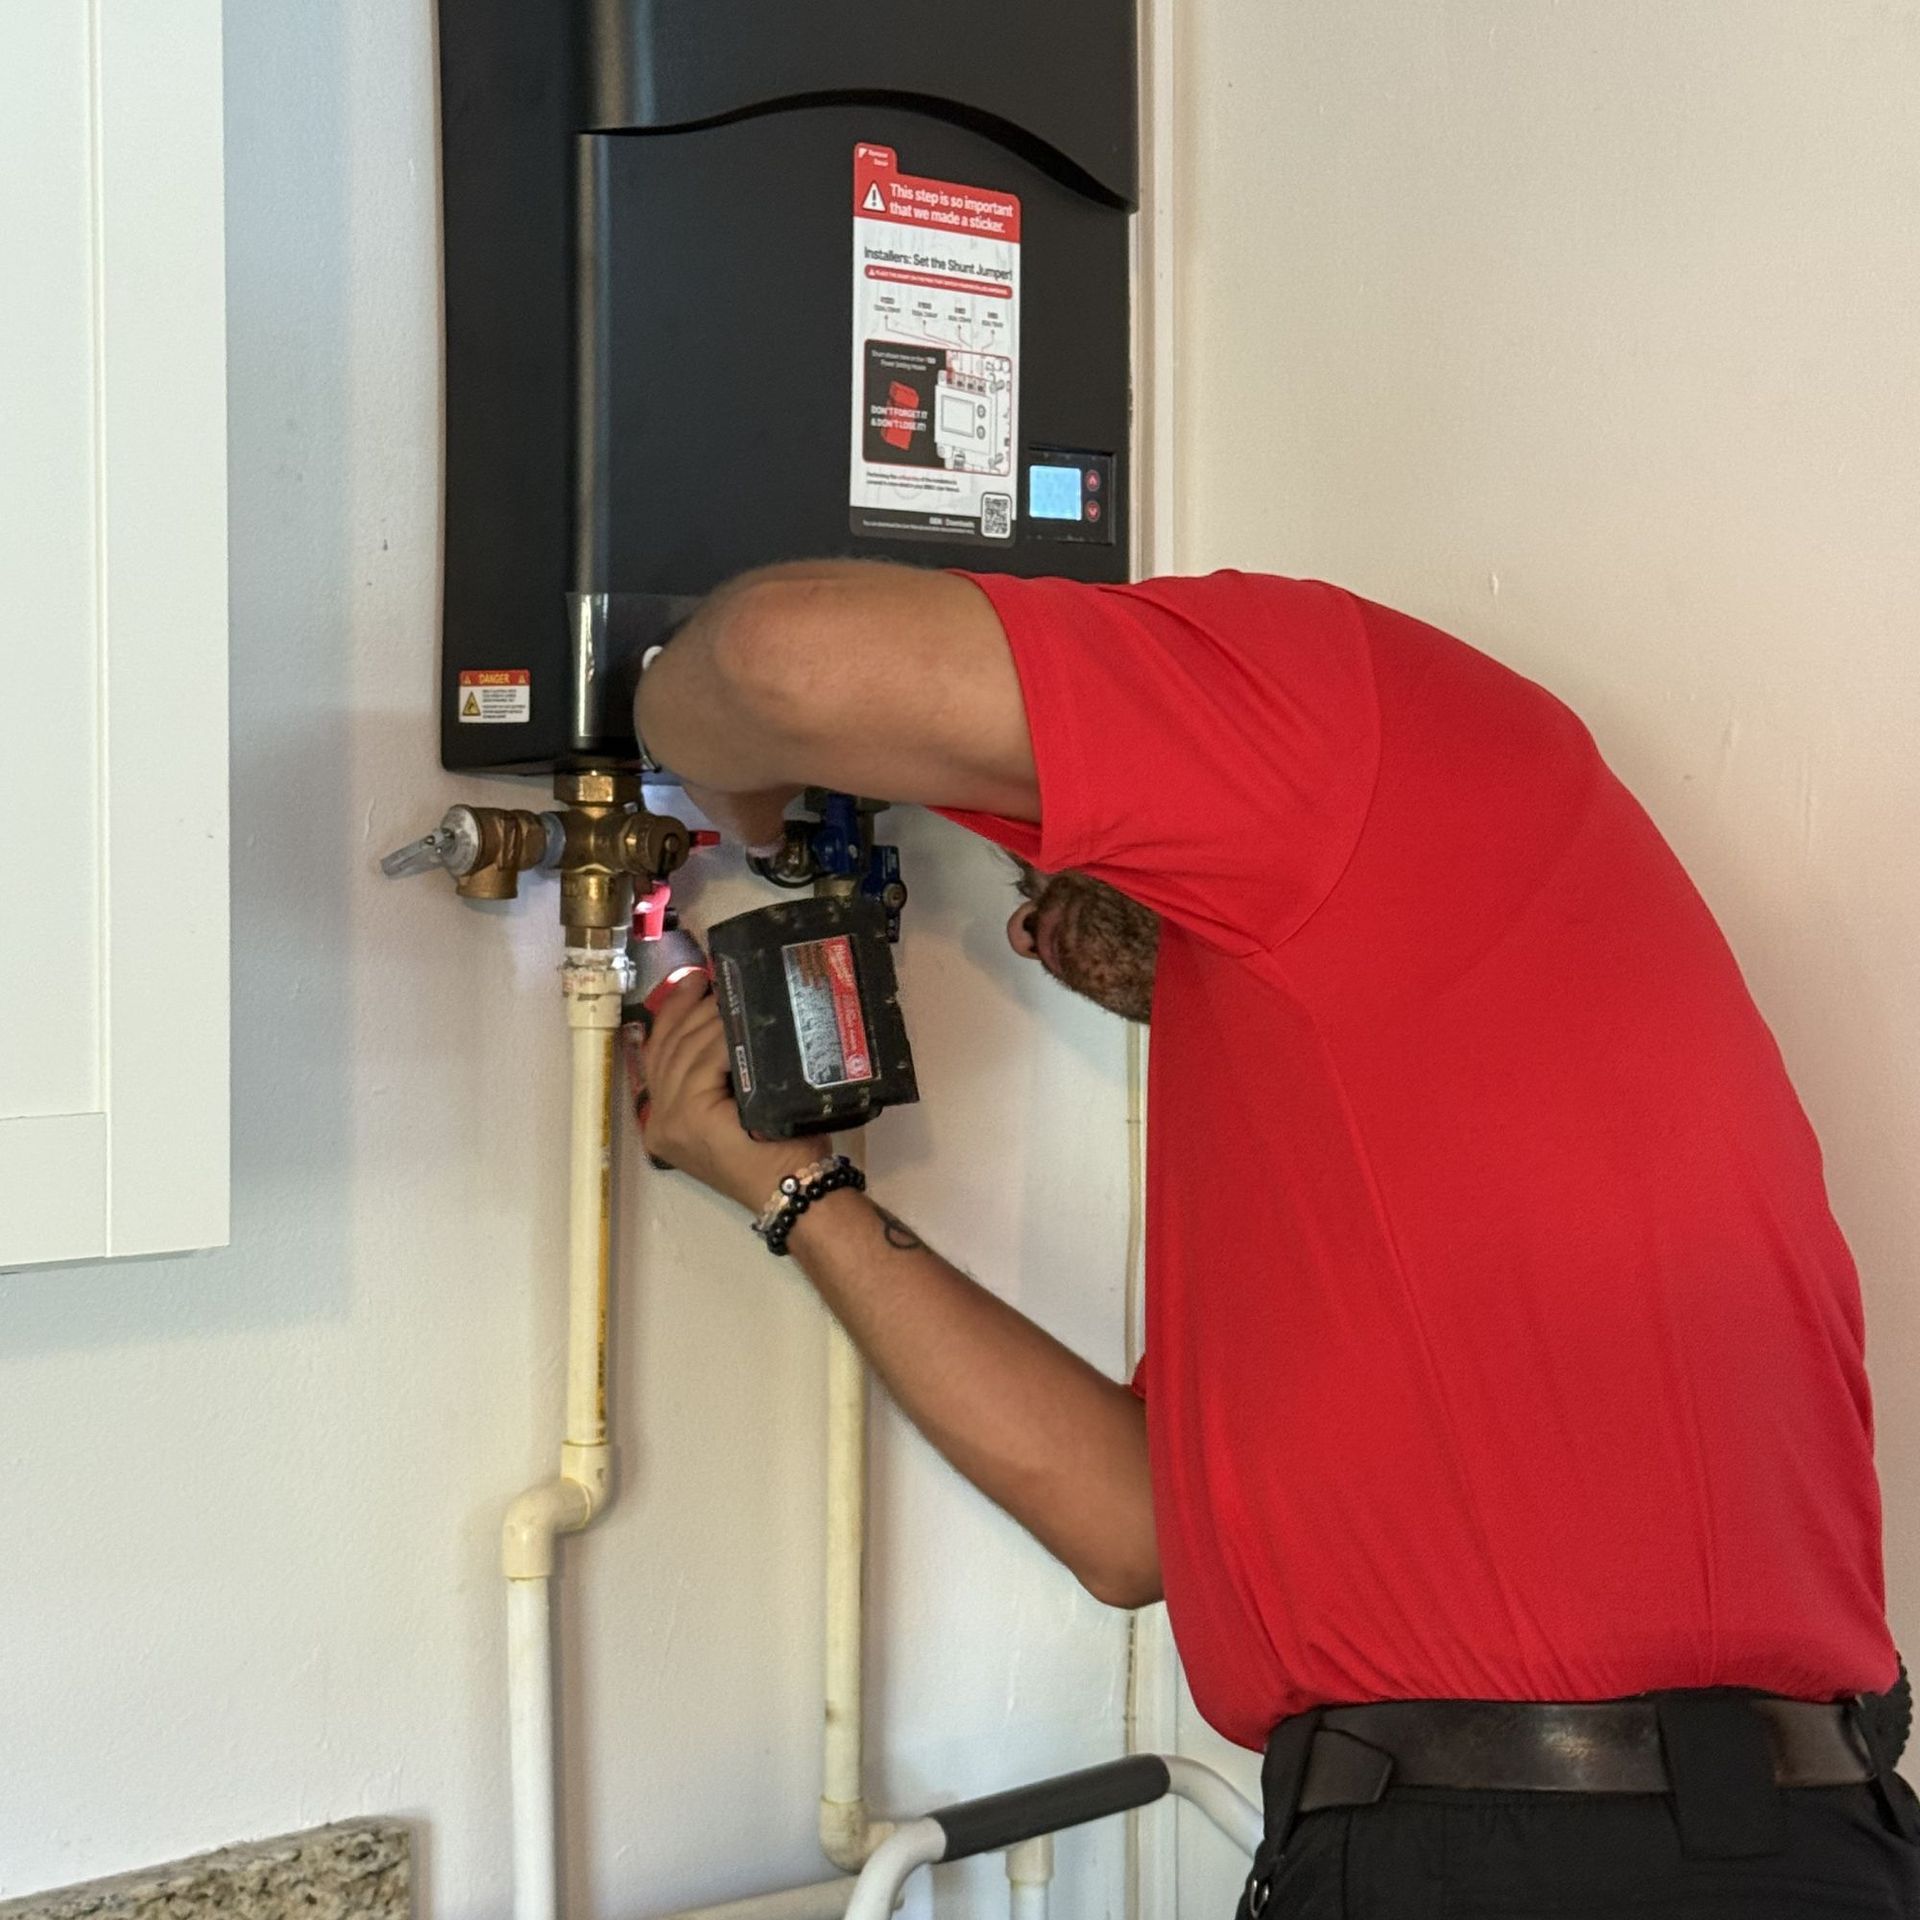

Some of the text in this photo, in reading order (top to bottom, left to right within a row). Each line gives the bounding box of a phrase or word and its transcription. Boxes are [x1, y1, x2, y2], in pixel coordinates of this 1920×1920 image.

[890, 183, 1013, 217] This step is so important
[889, 202, 1005, 233] that we made a sticker.
[864, 246, 912, 264] Installers:
[913, 254, 929, 268] Set
[931, 257, 946, 270] the
[948, 259, 974, 275] Shunt
[976, 267, 1013, 282] Jumper!
[479, 673, 510, 684] DANGER
